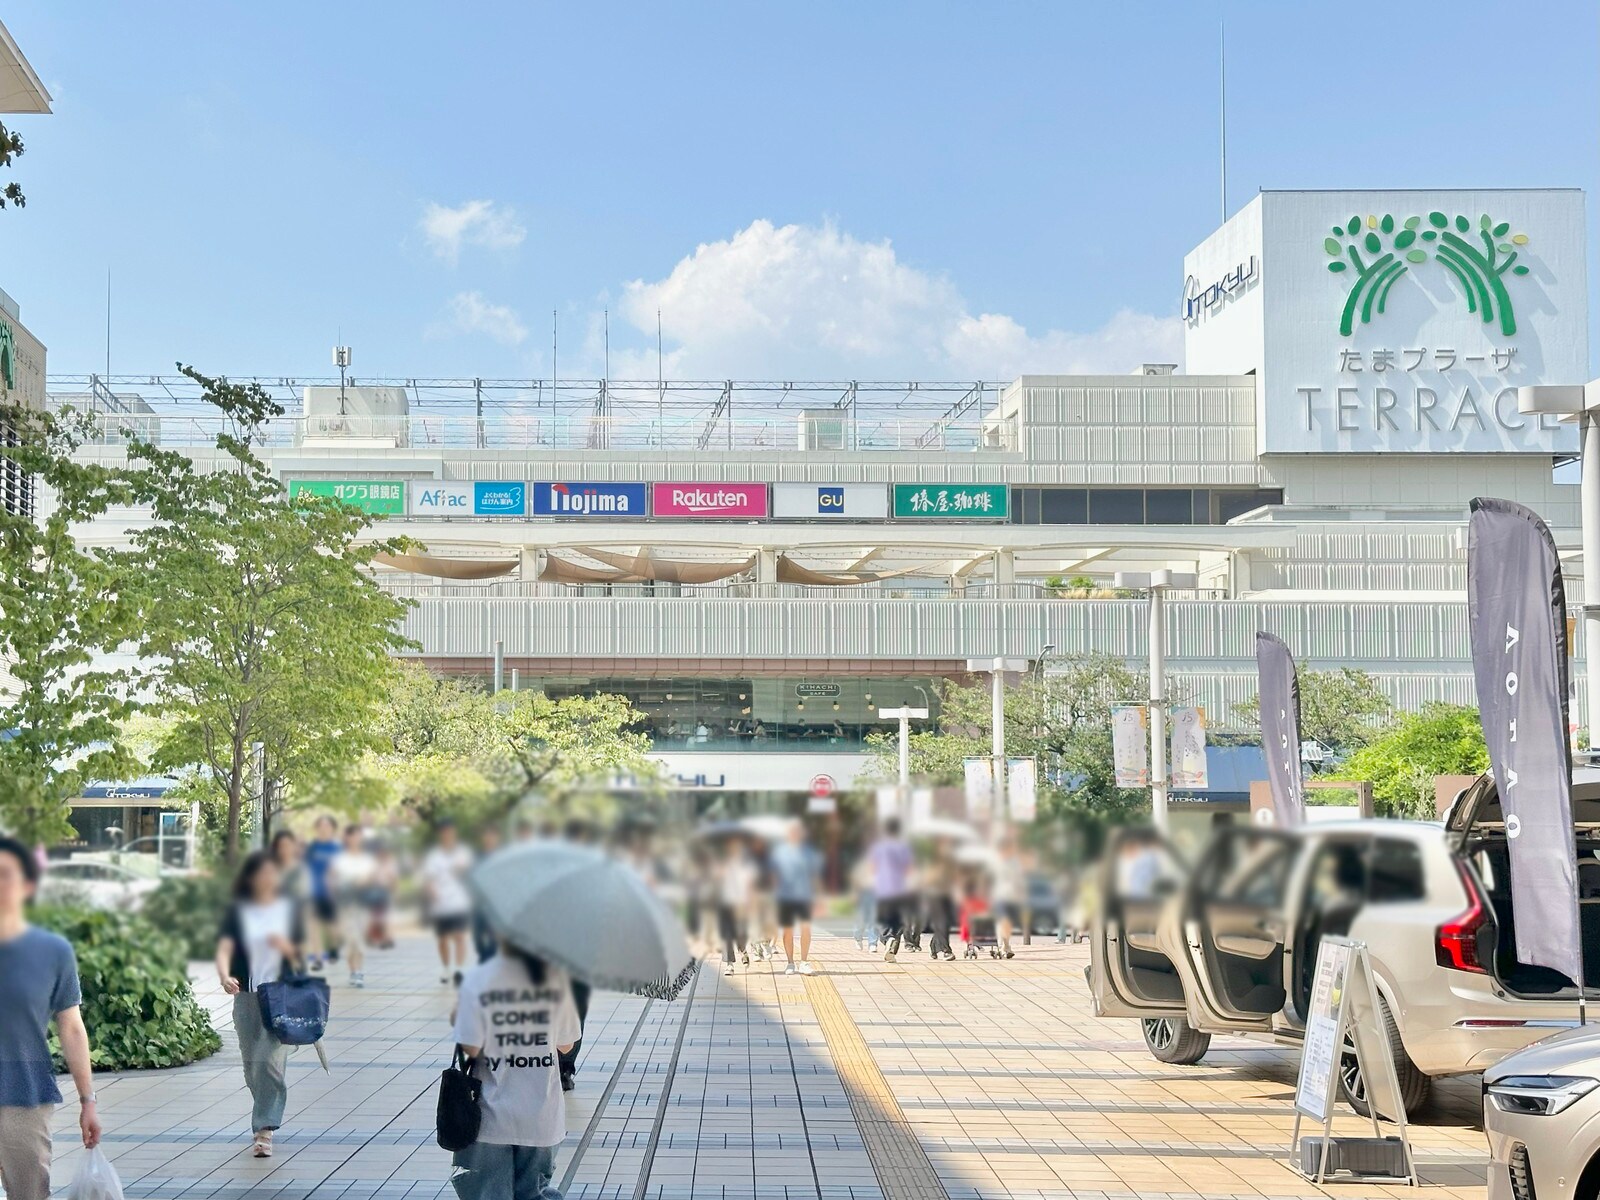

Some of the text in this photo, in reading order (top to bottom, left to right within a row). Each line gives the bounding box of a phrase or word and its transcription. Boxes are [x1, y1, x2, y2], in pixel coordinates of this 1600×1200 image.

[1193, 255, 1254, 315] TOKYU
[1338, 347, 1519, 373] たまプラーザ
[333, 484, 401, 500] オグラ眼鏡店
[419, 489, 467, 507] Aflac
[672, 489, 748, 507] Rakuten
[819, 494, 843, 507] GU
[492, 1010, 550, 1026] COME
[495, 1032, 548, 1047] TRUE
[504, 1053, 555, 1068] Hond
